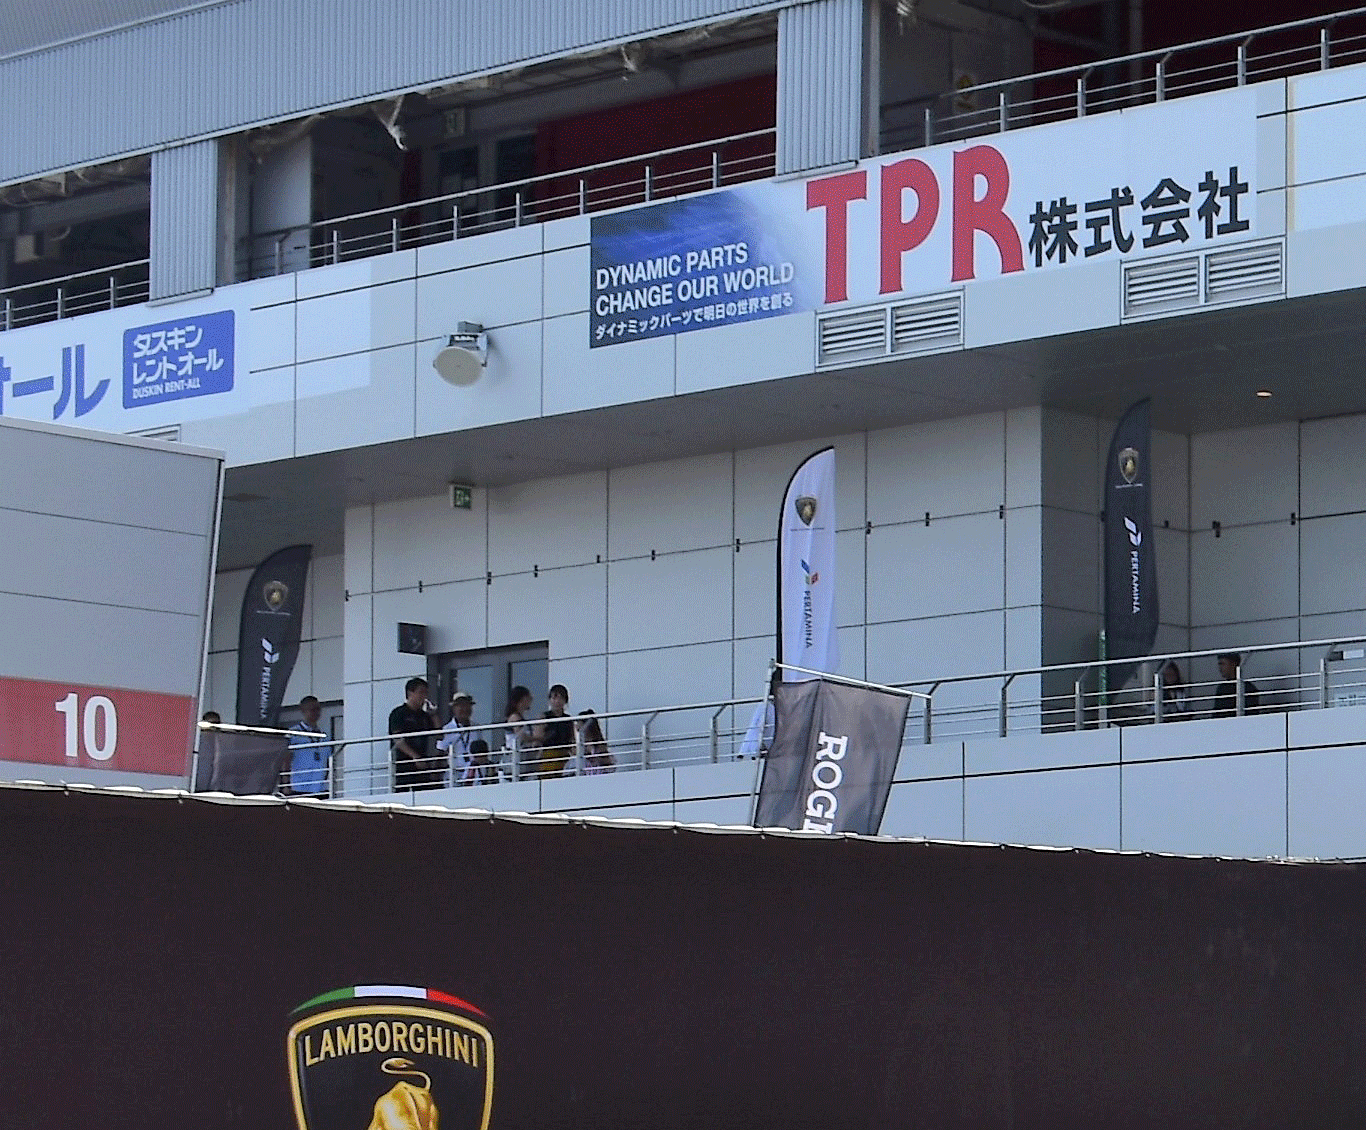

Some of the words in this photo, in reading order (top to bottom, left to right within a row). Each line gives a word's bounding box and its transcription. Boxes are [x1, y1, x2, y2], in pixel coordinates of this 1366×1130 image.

[805, 144, 1025, 304] TPR
[1029, 166, 1250, 268] 株式会社
[595, 283, 673, 317] CHANGE
[677, 275, 719, 302] OUR
[723, 262, 795, 293] WORLD
[596, 255, 682, 290] DYNAMIC
[686, 242, 749, 273] PARTS
[0, 343, 111, 421] ール
[55, 692, 118, 761] 10
[303, 1021, 479, 1068] LAMBORGHINI
